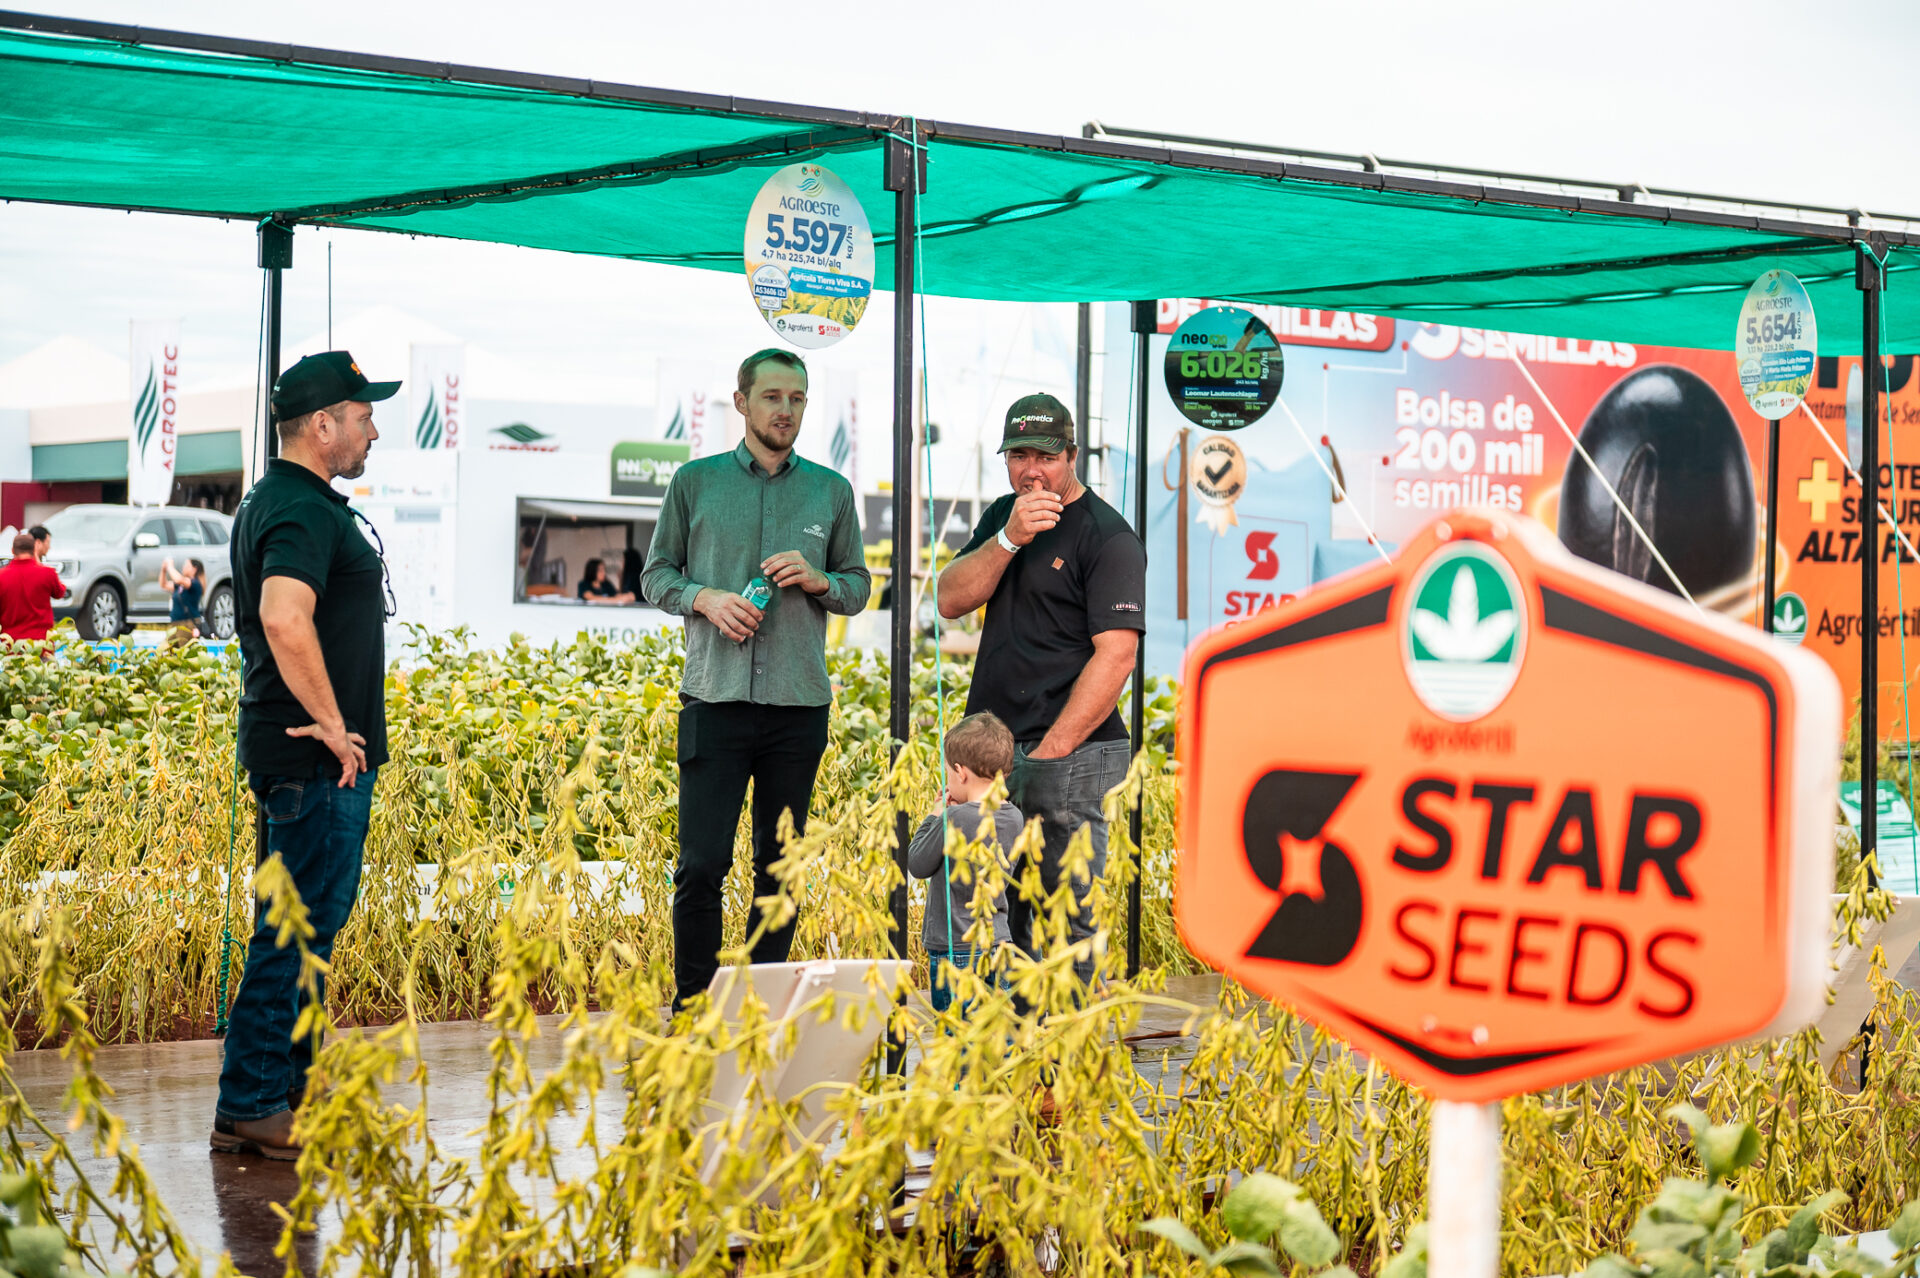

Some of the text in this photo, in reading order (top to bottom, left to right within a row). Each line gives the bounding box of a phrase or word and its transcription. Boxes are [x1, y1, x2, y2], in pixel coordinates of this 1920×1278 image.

[779, 195, 840, 217] AGROESTE
[766, 213, 847, 257] 5.597
[846, 225, 854, 260] kg/ha
[776, 251, 786, 260] ha
[789, 252, 815, 264] 225,74
[1208, 299, 1378, 343] MILLAS
[1746, 312, 1797, 345] 5.654
[1181, 350, 1261, 379] 6.026
[1260, 351, 1269, 380] kg/ha
[1461, 328, 1637, 368] SEMILLAS
[161, 344, 178, 471] AGROTEC
[691, 392, 705, 448] OTEC
[1396, 388, 1534, 432] Bolsa de
[1395, 426, 1543, 475] 200 mil
[1394, 474, 1523, 512] semillas
[1844, 464, 1920, 490] POTE
[1842, 498, 1920, 524] SGUR
[1816, 606, 1920, 645] Agrértil
[1392, 776, 1705, 900] STAR
[1387, 902, 1702, 1020] SEEDS
